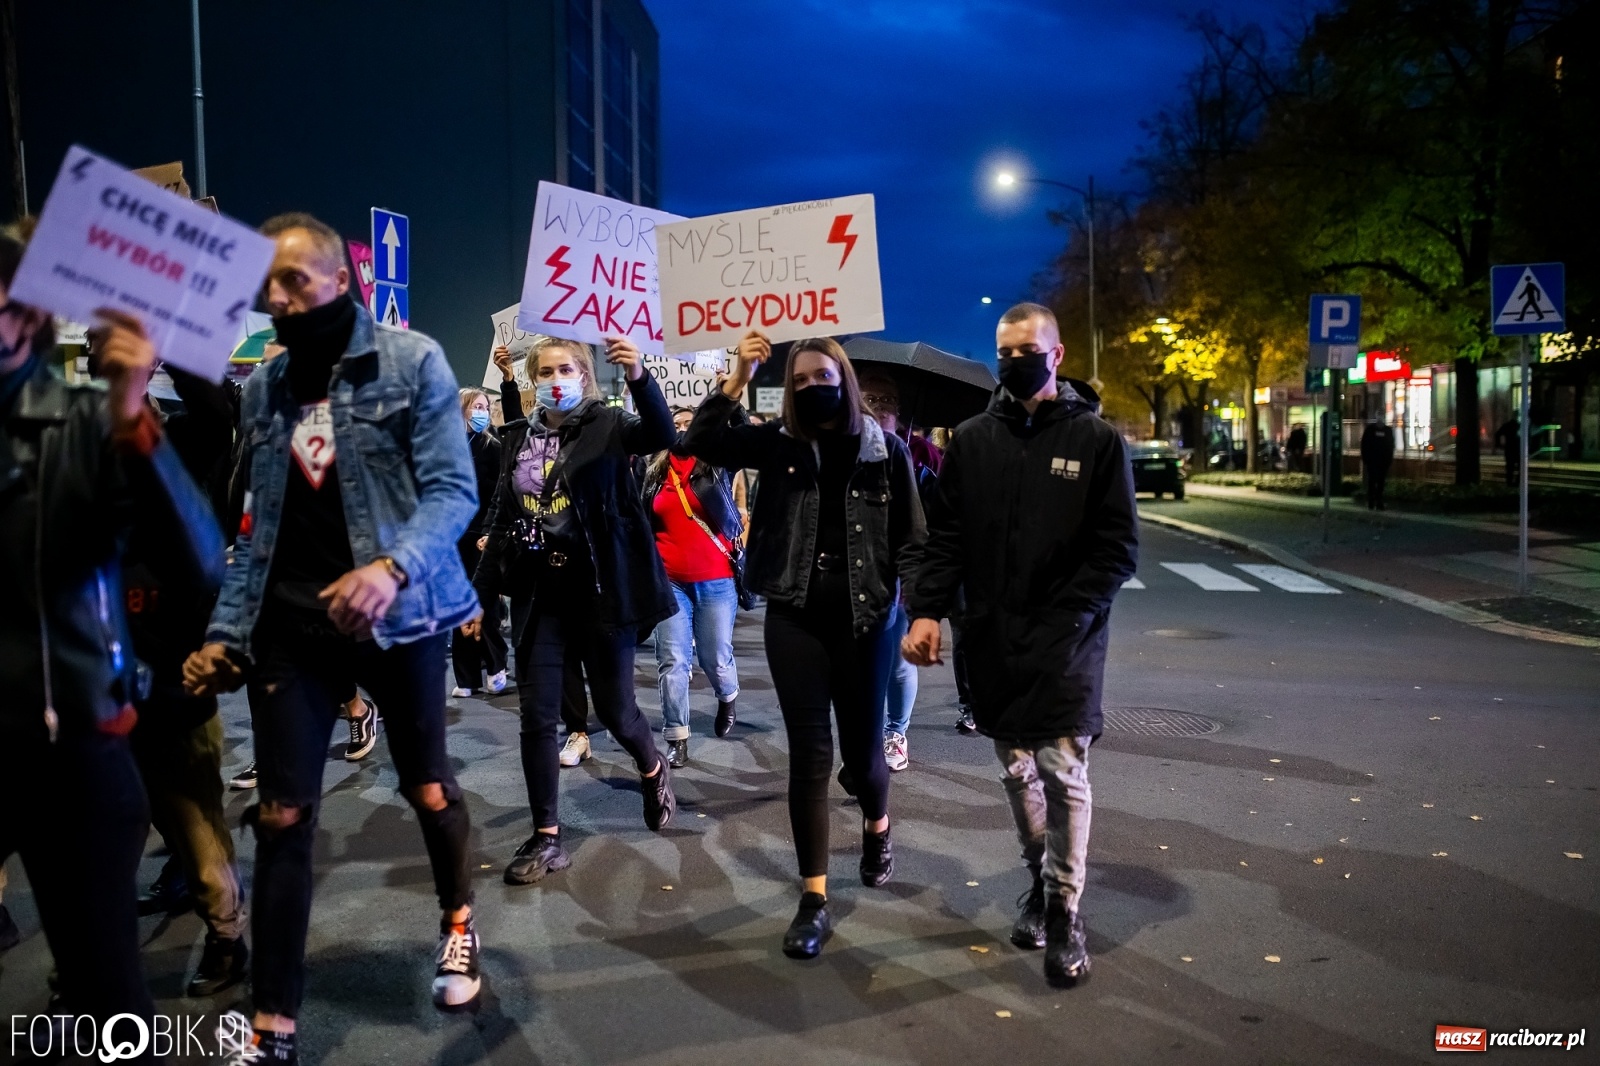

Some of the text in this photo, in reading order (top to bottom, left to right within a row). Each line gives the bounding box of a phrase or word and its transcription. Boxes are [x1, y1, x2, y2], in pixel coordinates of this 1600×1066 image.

[100, 186, 237, 262] CHCĘ MIEĆ
[544, 194, 656, 256] WYBÓR
[668, 217, 774, 268] MYŚLĘ
[87, 224, 186, 284] WYBÓR
[591, 253, 647, 293] NIE
[721, 254, 811, 287] CZUJĘ
[542, 281, 664, 341] ZAKA
[678, 287, 839, 336] DECYDUJĘ
